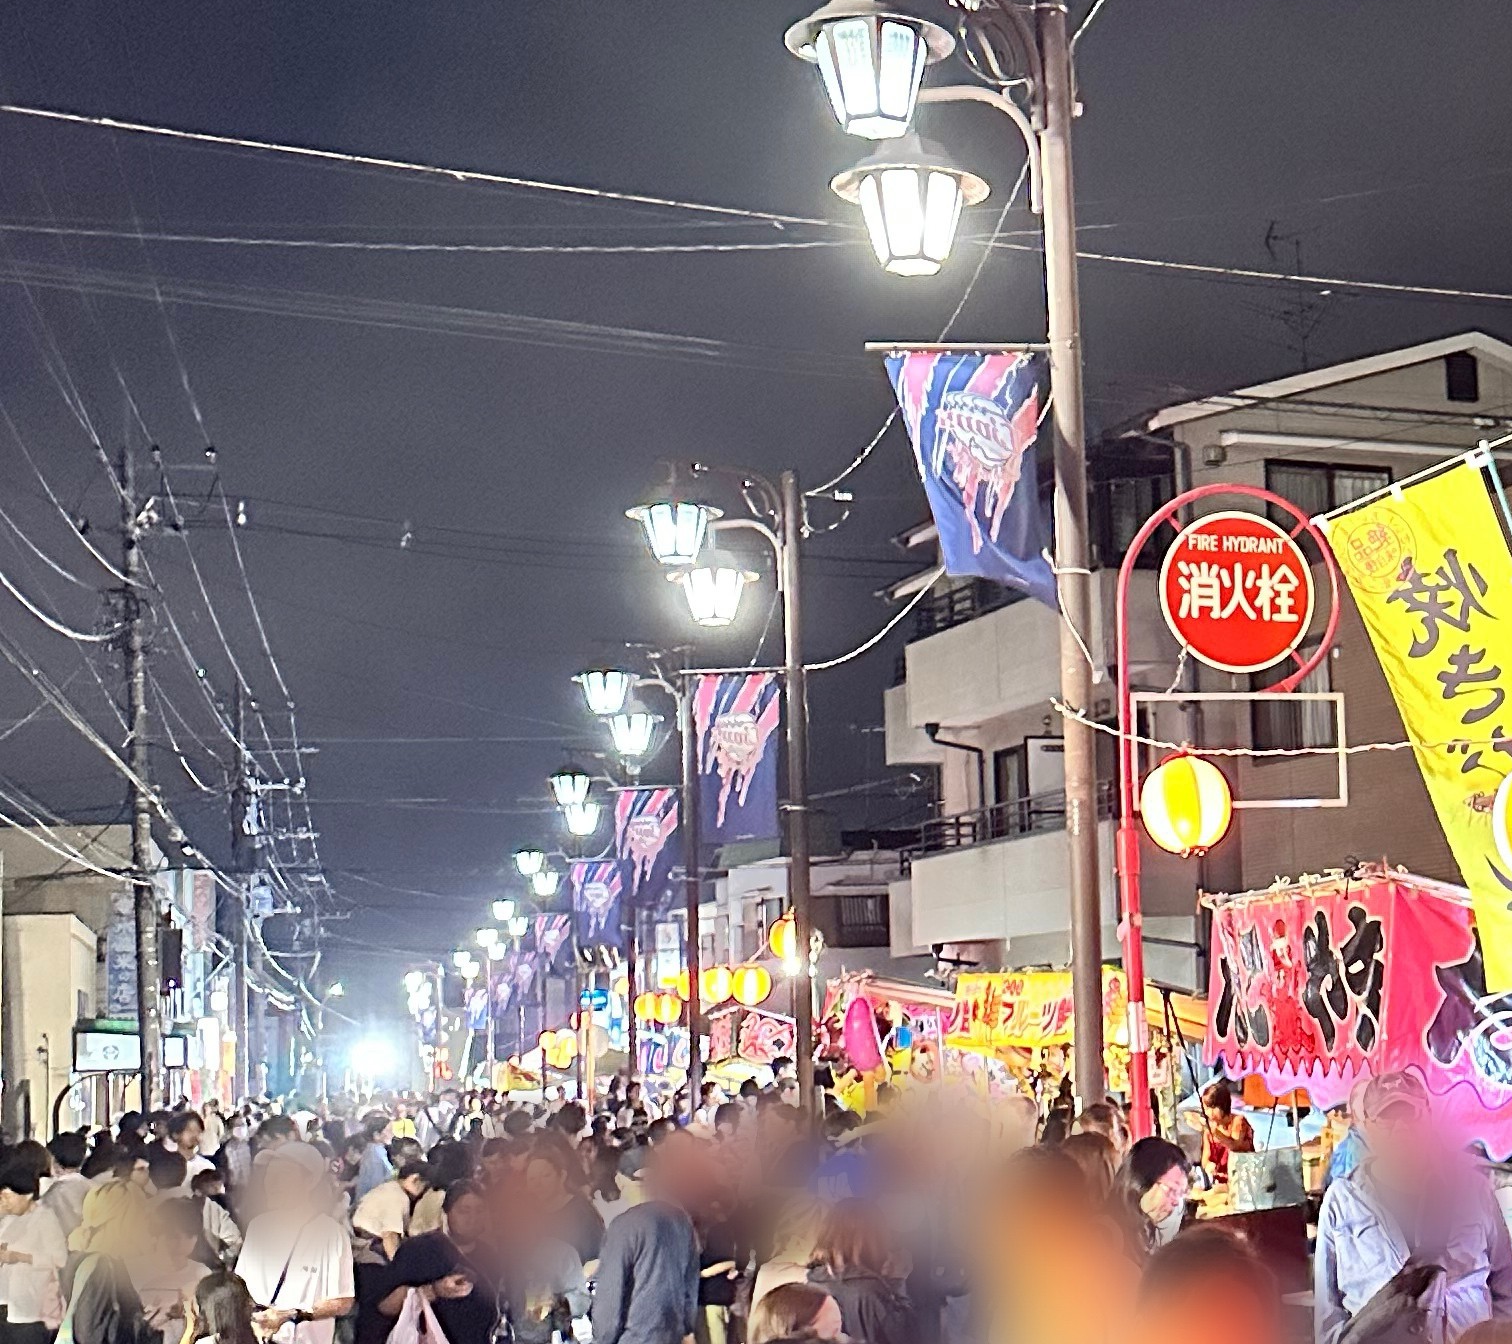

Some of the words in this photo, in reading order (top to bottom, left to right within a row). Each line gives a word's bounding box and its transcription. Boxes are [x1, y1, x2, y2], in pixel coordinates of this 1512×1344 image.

[1188, 533, 1219, 552] FIRE
[1222, 536, 1286, 555] HYDRANT
[1177, 560, 1300, 623] 消火栓
